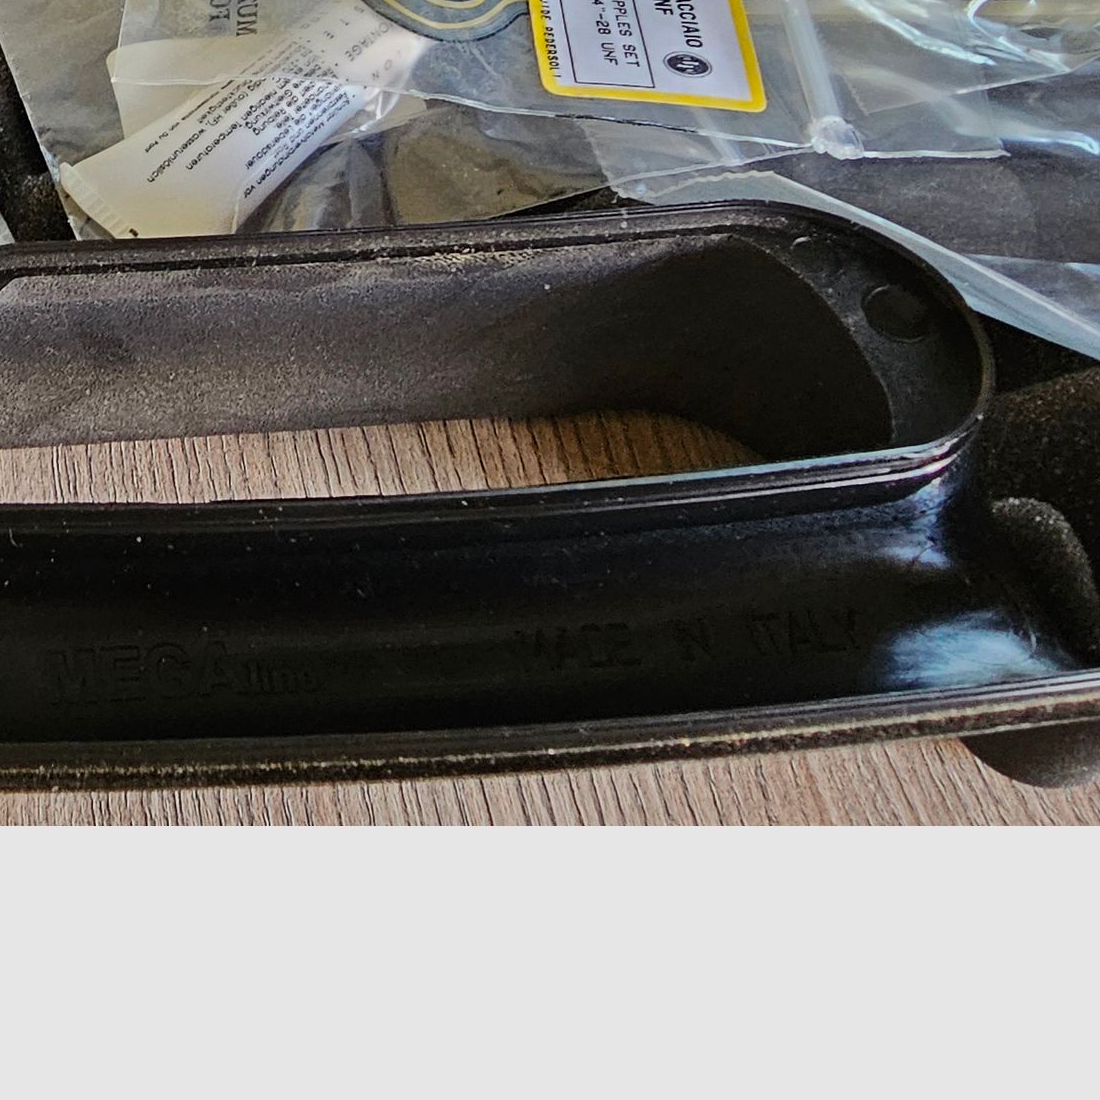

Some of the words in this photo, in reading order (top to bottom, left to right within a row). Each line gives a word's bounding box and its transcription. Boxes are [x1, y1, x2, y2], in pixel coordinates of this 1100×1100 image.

[542, 26, 561, 78] PEDERSOLI
[601, 42, 617, 66] UNF
[621, 43, 640, 68] SET
